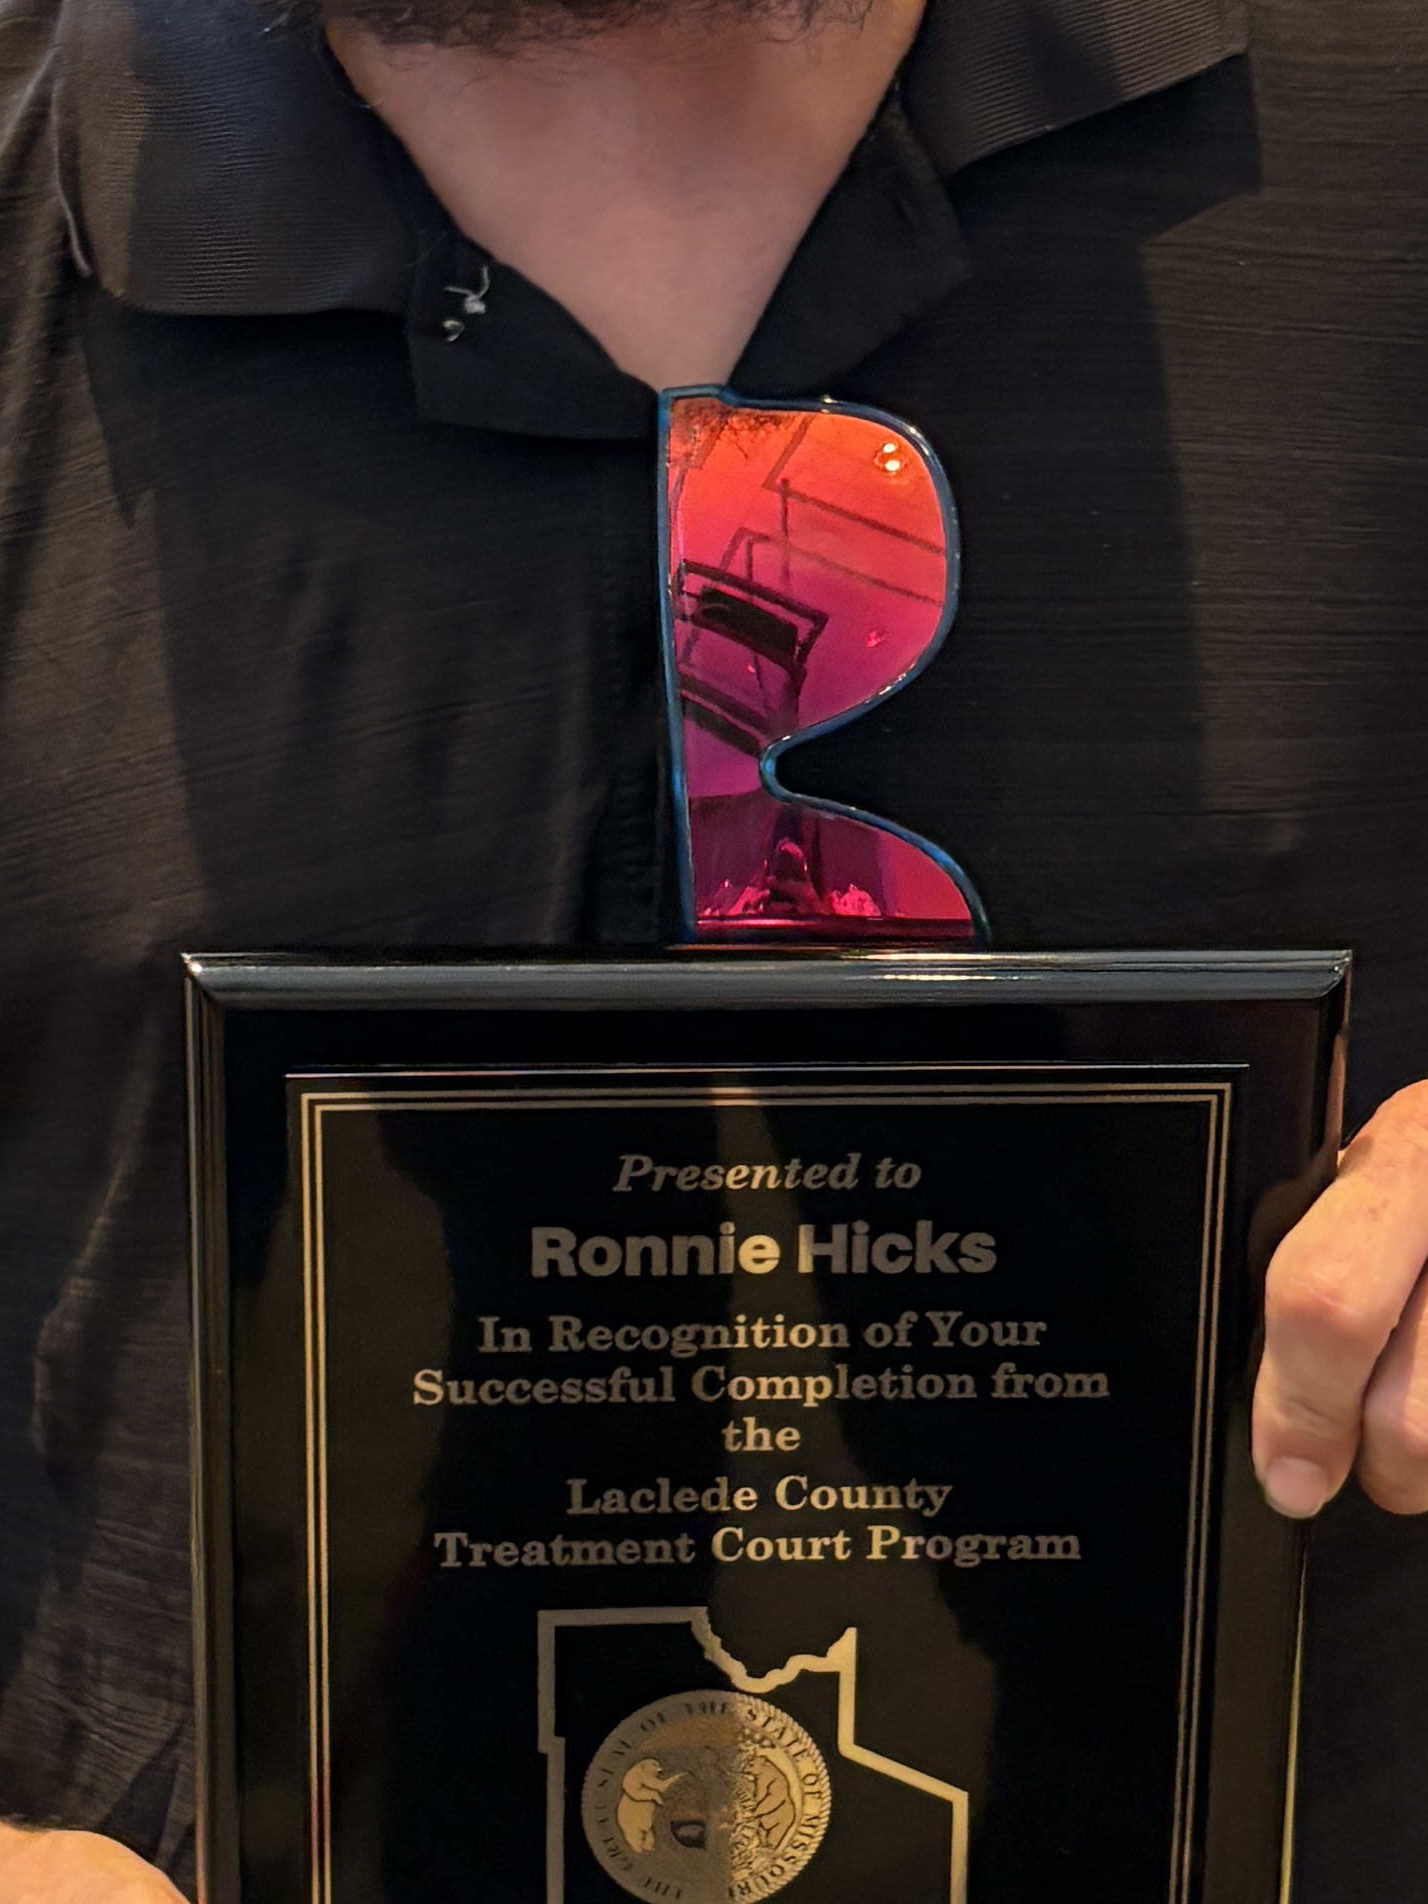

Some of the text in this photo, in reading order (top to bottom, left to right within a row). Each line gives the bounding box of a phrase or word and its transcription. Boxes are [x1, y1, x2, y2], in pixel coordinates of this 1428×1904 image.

[611, 1152, 923, 1193] Presented to
[530, 1219, 998, 1279] Ronnie Hicks
[477, 1310, 1048, 1359] In Recognition of Your
[412, 1361, 1111, 1409] Successful Completion from
[720, 1415, 802, 1453] the
[565, 1474, 954, 1518] Laclede County
[433, 1524, 1082, 1569] Treatment Court Program
[746, 1707, 808, 1760] STATE
[801, 1772, 822, 1803] OF
[727, 1813, 823, 1900] MISSOURI
